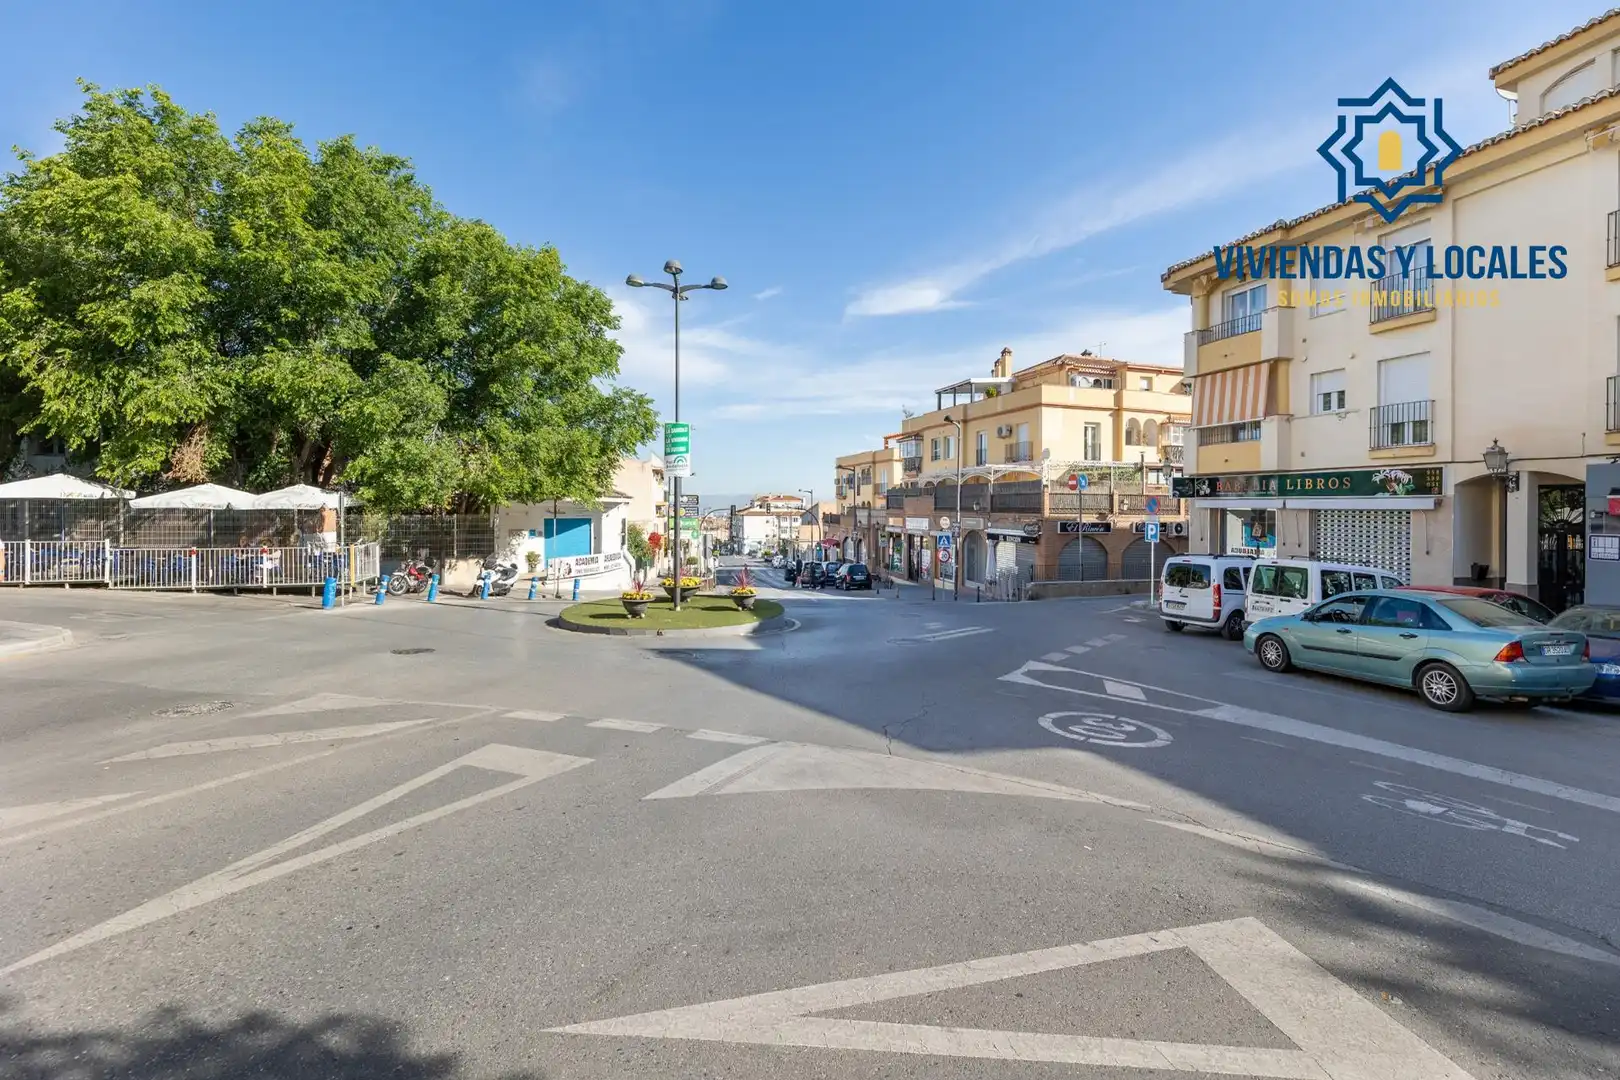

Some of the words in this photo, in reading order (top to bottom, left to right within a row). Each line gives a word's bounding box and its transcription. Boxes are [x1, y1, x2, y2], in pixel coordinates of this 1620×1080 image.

[1286, 477, 1351, 490] LIBROS
[1147, 524, 1157, 540] P
[575, 556, 599, 566] ACADEMIA
[1069, 718, 1137, 739] 30
